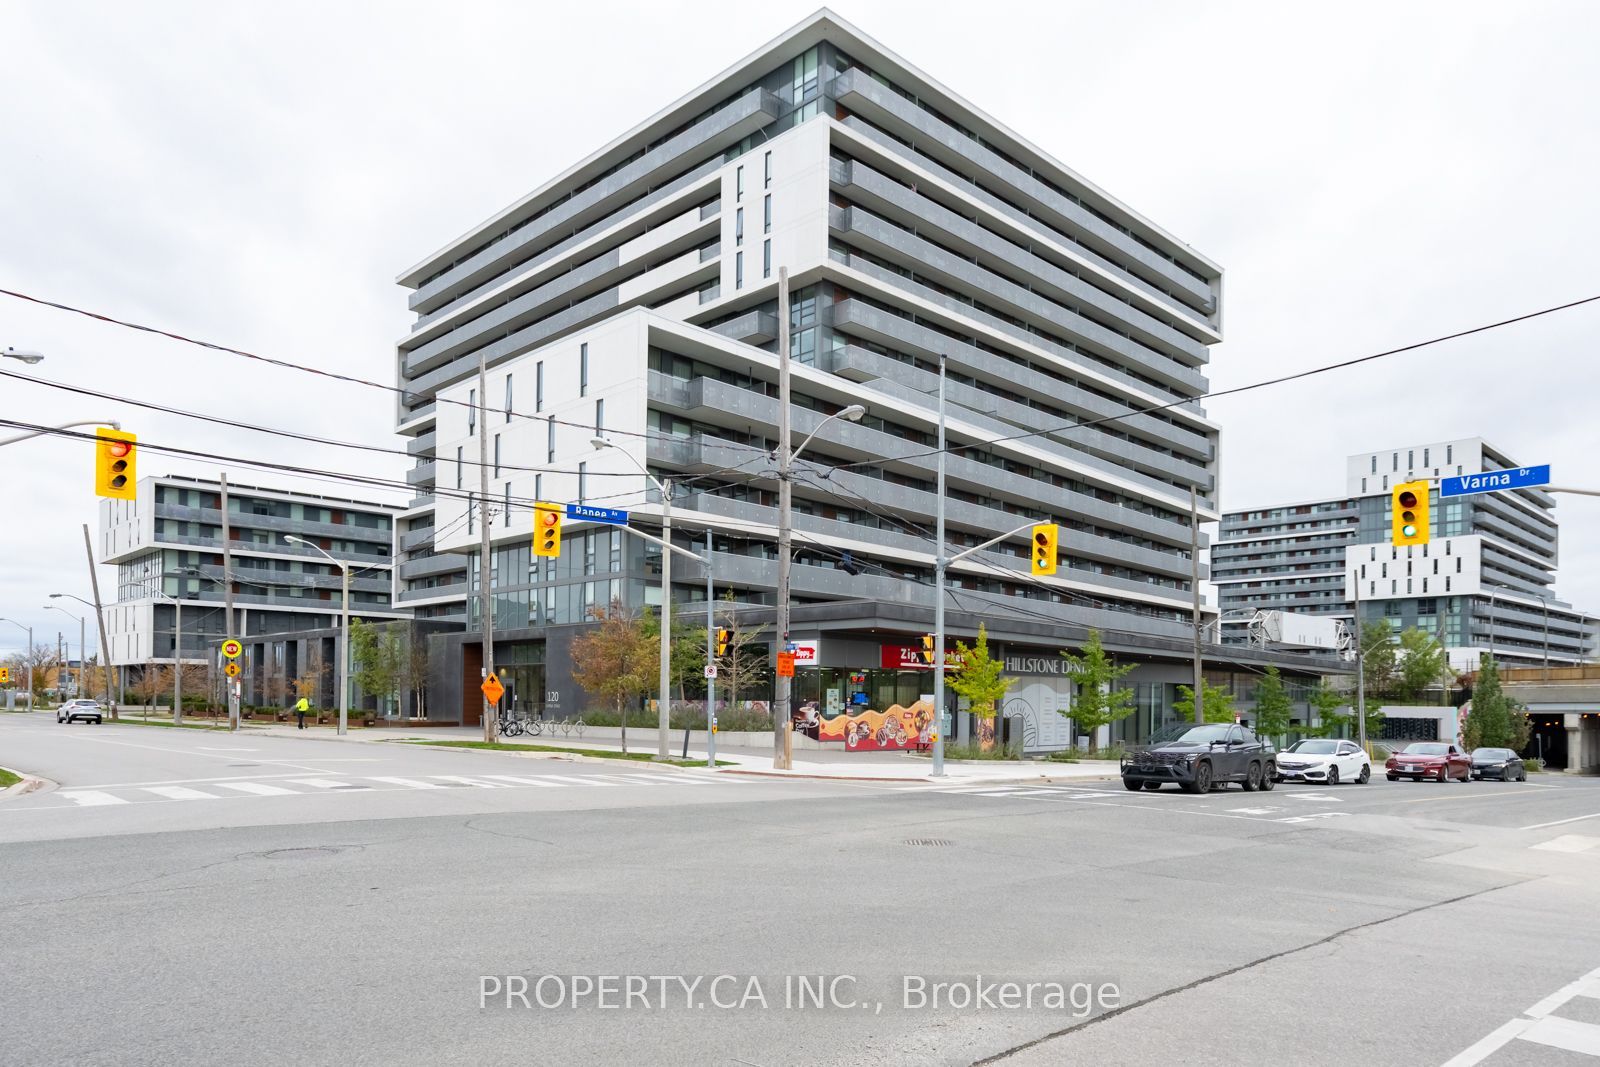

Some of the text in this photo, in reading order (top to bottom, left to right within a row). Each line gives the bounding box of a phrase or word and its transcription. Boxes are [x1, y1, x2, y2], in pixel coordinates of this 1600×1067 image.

[1460, 469, 1530, 490] Varna Dr
[575, 506, 607, 517] Ranee
[1006, 657, 1088, 674] HILLSTONE DENT
[547, 691, 559, 702] 120
